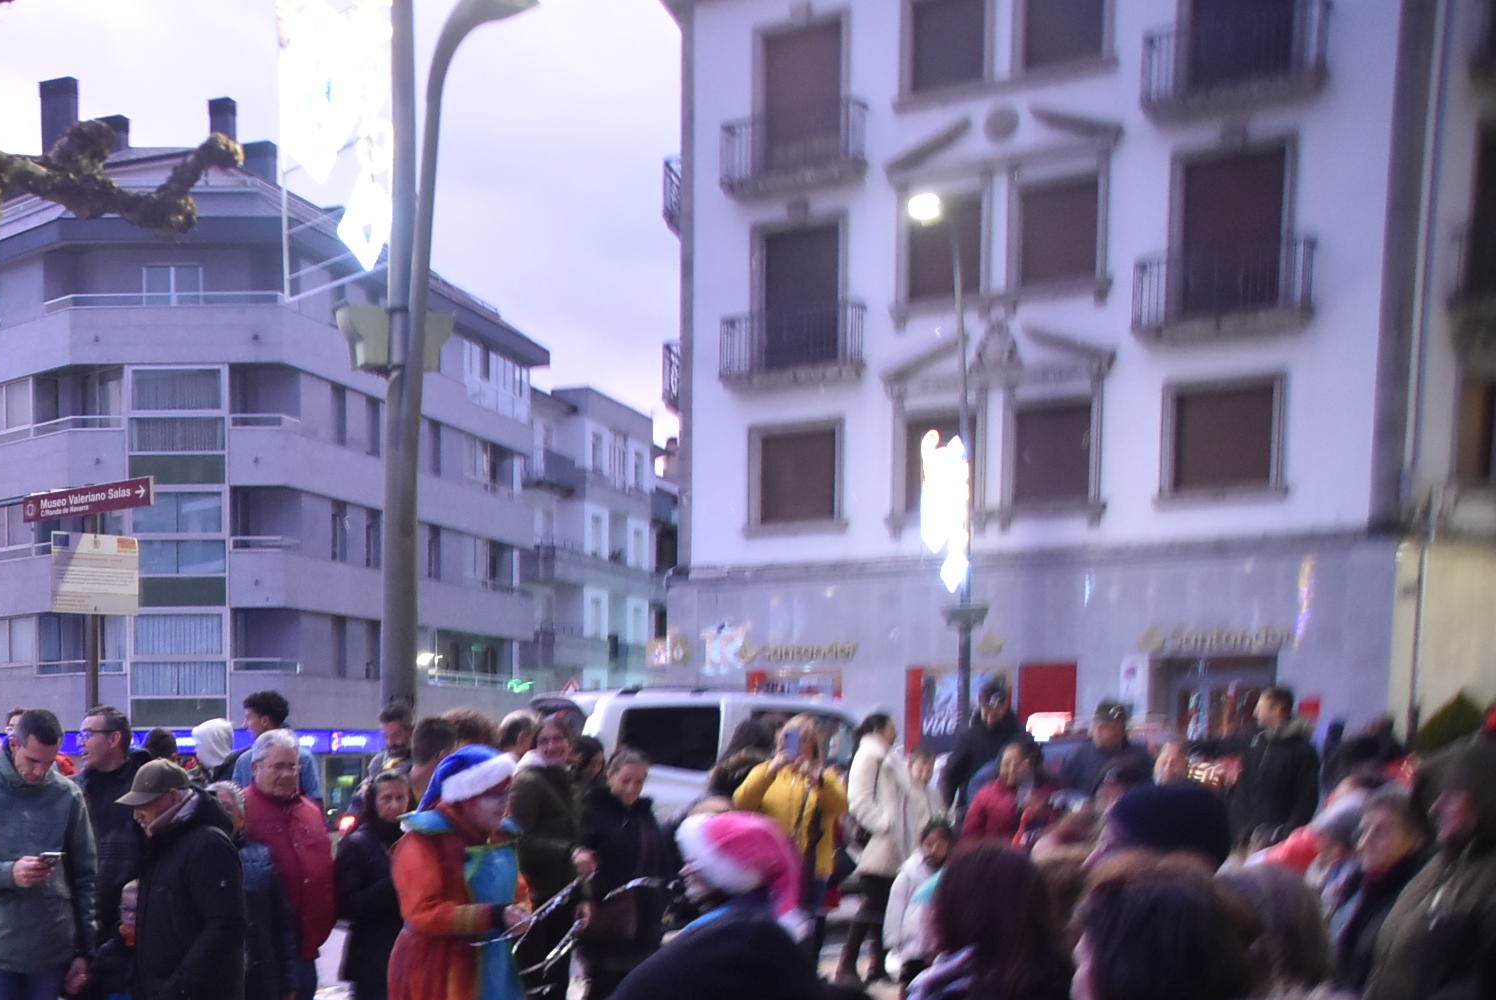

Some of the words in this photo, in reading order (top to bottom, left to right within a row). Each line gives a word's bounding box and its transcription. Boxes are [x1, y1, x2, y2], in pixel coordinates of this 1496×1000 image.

[40, 498, 67, 509] Museo
[68, 492, 106, 505] Valeriano
[108, 488, 131, 500] Salas
[70, 504, 89, 513] Navarra
